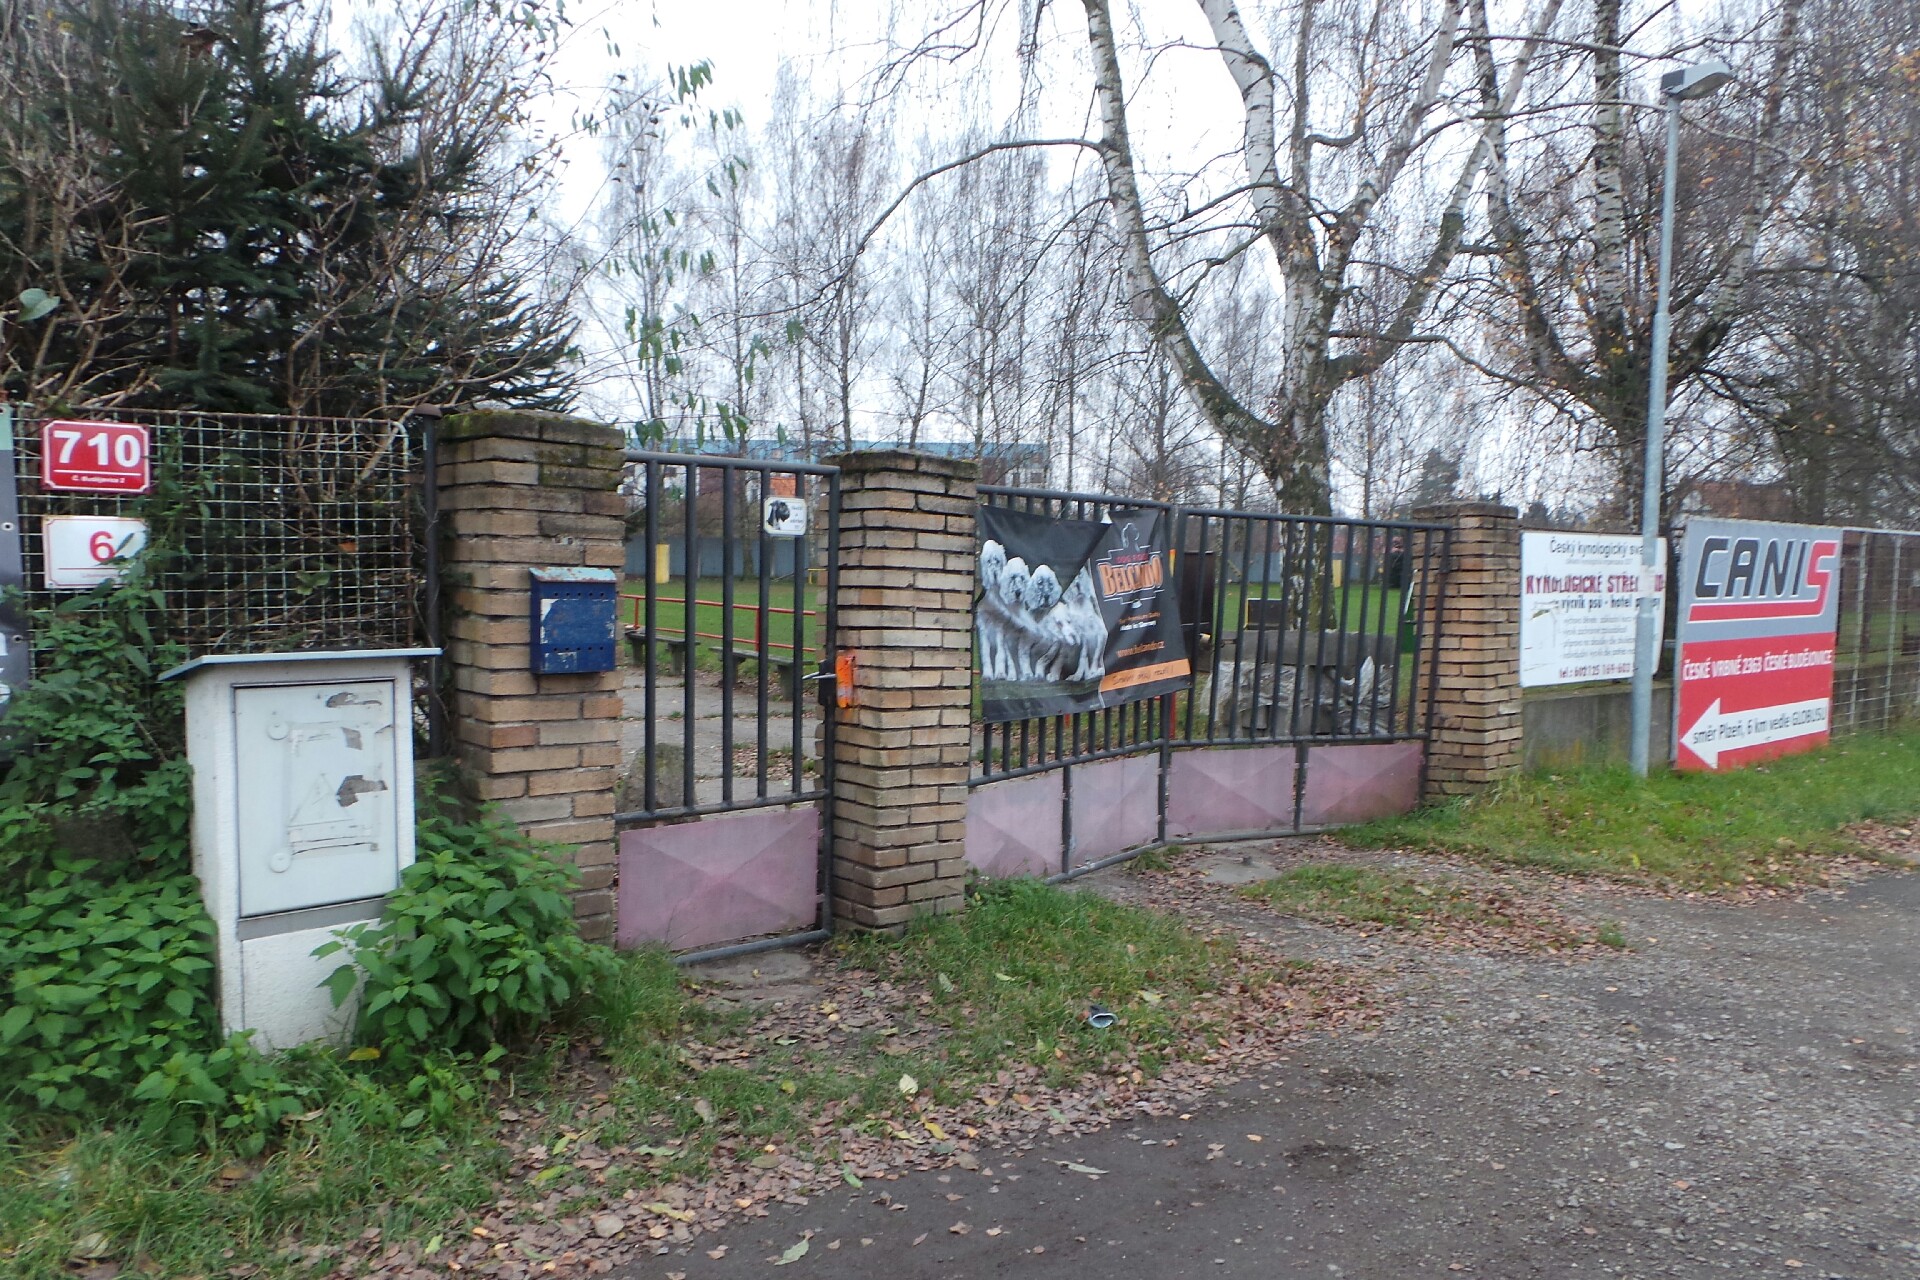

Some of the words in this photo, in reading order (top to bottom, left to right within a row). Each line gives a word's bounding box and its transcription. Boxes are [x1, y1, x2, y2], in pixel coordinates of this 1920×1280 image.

[53, 430, 141, 468] 710
[89, 530, 115, 563] 6
[1550, 536, 1575, 557] Český
[1695, 535, 1839, 601] CANIS
[1682, 657, 1711, 681] ČESKÉ
[1754, 717, 1767, 734] km
